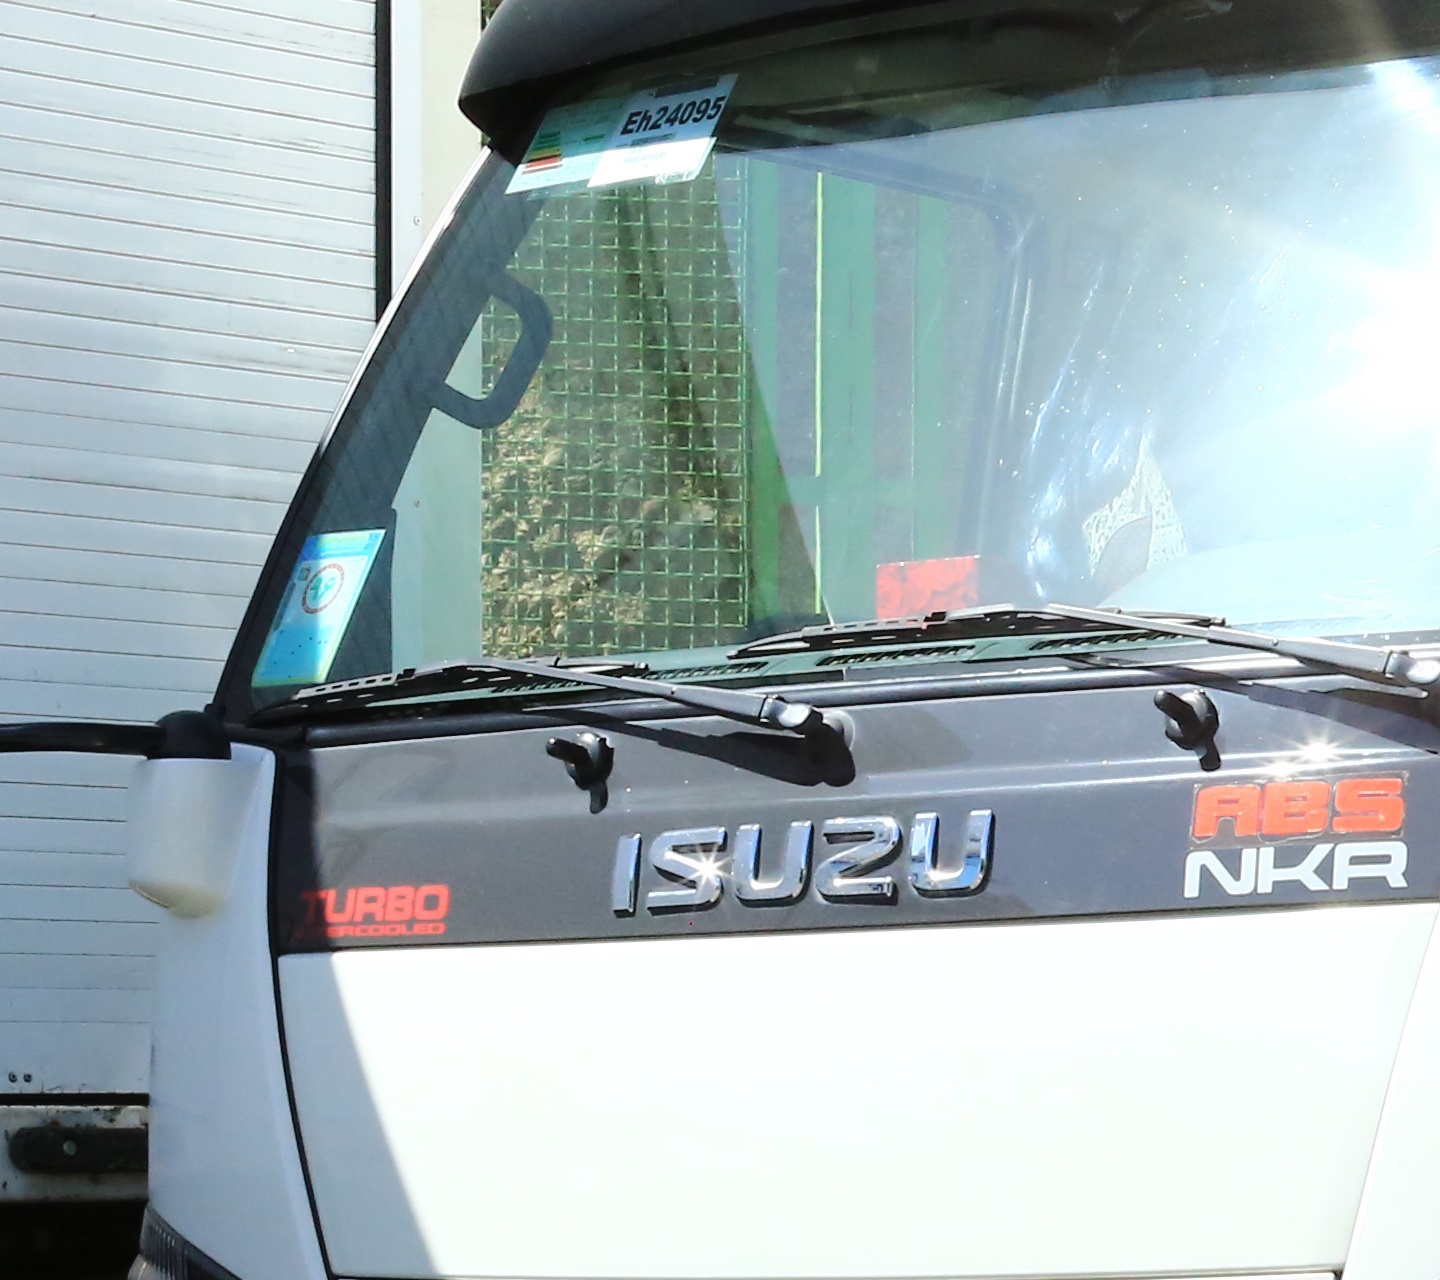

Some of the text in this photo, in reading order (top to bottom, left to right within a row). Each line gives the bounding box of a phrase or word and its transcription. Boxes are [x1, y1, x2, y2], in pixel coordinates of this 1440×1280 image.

[620, 95, 726, 135] Eh24095
[1193, 777, 1405, 838] ABS
[612, 809, 994, 917] ISUZU
[1183, 840, 1409, 899] NKR
[301, 884, 450, 923] TURBO
[295, 922, 446, 939] ERCOOLED
